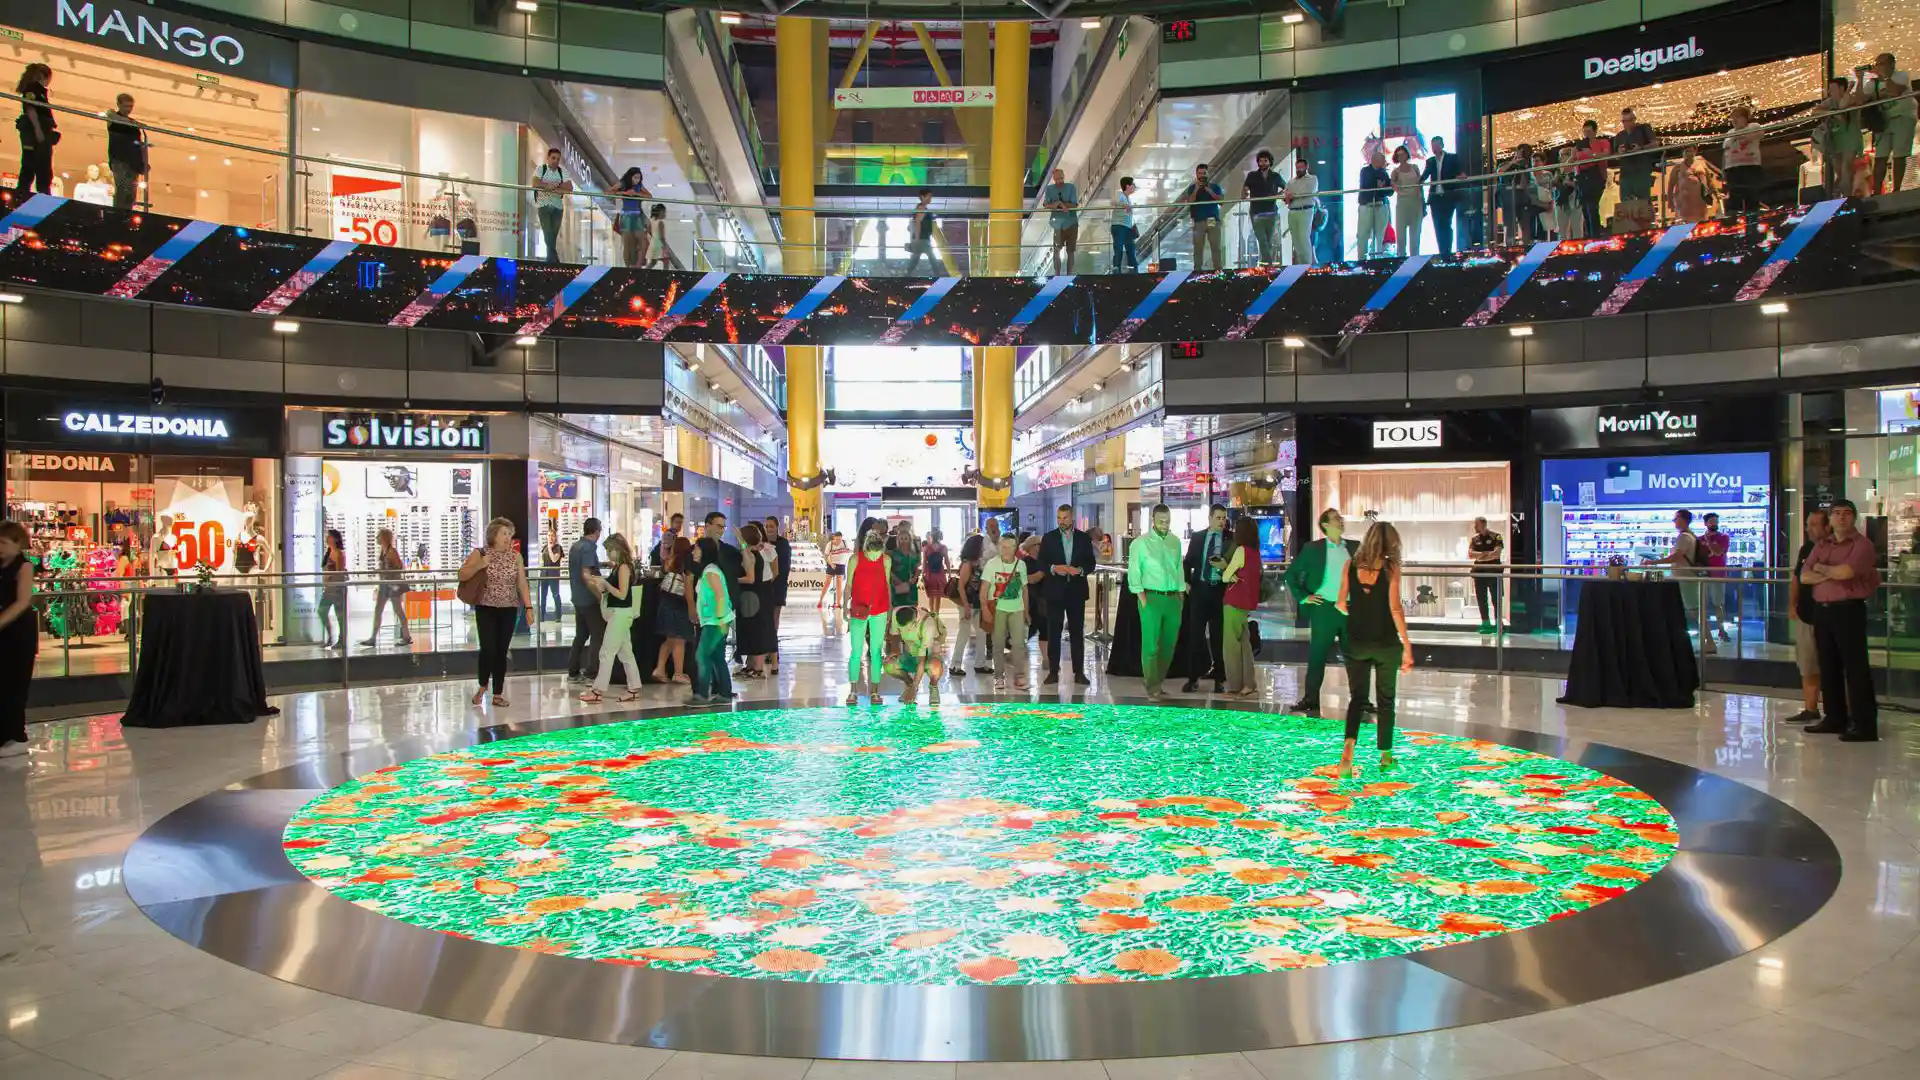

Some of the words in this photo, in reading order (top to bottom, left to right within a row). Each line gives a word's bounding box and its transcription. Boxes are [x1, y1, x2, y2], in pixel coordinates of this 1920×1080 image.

[57, 0, 244, 66] MANGO
[564, 136, 592, 187] MANGO
[65, 413, 229, 437] CALZEDONIA
[1599, 410, 1697, 432] MovilYou
[1376, 426, 1438, 442] TOUS
[912, 488, 947, 496] AGATHA
[1648, 472, 1742, 490] MovilYou
